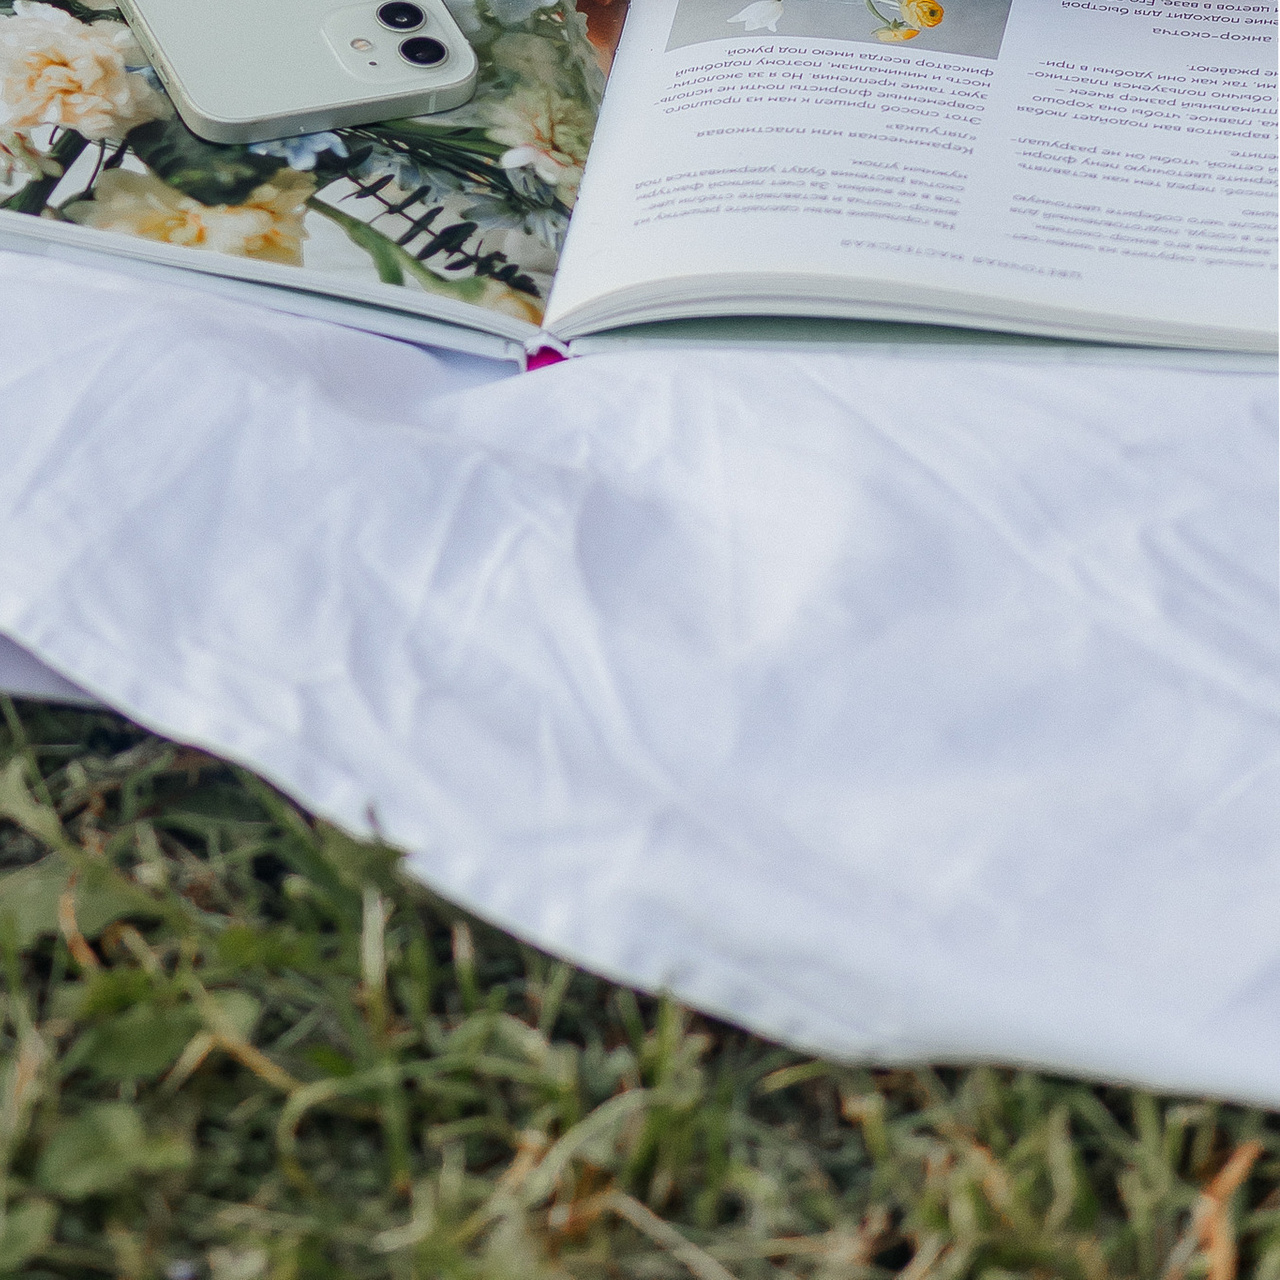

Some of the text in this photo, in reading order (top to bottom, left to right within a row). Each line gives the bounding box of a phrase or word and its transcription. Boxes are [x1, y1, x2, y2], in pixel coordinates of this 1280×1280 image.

[1061, 1, 1129, 16] быстрой
[1161, 0, 1198, 8] вазе.
[1216, 4, 1269, 13] цветов
[1134, 9, 1162, 17] для
[1166, 12, 1240, 24] подходит
[1152, 28, 1272, 42] анкор-скотча
[725, 45, 994, 77] фиксатор всегда имею под рукой.
[756, 57, 822, 68] поэтому
[1039, 61, 1075, 69] при-
[675, 60, 752, 78] подобный
[1093, 66, 1153, 79] удобны
[666, 72, 744, 90] экологич-
[782, 72, 803, 80] Но
[809, 73, 896, 87] крепления.
[946, 76, 991, 88] ность
[1157, 75, 1186, 83] они
[789, 84, 872, 98] флористы
[900, 82, 945, 95] такие
[1027, 71, 1272, 102] обычно пользуемся пластико-
[654, 87, 713, 106] исполь-
[950, 89, 988, 100] зуют
[1069, 88, 1114, 99] ячеек
[814, 99, 876, 110] пришел
[876, 92, 985, 112] современные
[1032, 95, 1094, 109] хорошо
[1119, 93, 1176, 107] размер
[880, 104, 940, 118] способ
[1098, 104, 1127, 113] она
[1132, 108, 1181, 119] чтобы
[943, 113, 982, 125] Этот
[1016, 106, 1270, 139] вариантов вам подойдет любая
[811, 128, 844, 136] или
[848, 132, 974, 155] Керамическая
[1010, 138, 1097, 154] разрушал-
[1015, 151, 1077, 164] флори-
[1125, 152, 1145, 160] он
[1149, 155, 1199, 166] чтобы
[1081, 158, 1119, 169] пену
[780, 165, 826, 177] будут
[1018, 162, 1098, 179] вставлять
[1124, 165, 1212, 179] цветочную
[634, 178, 662, 190] под
[1102, 175, 1129, 183] как
[1134, 178, 1161, 187] тем
[810, 181, 830, 190] За
[1166, 181, 1216, 193] перед
